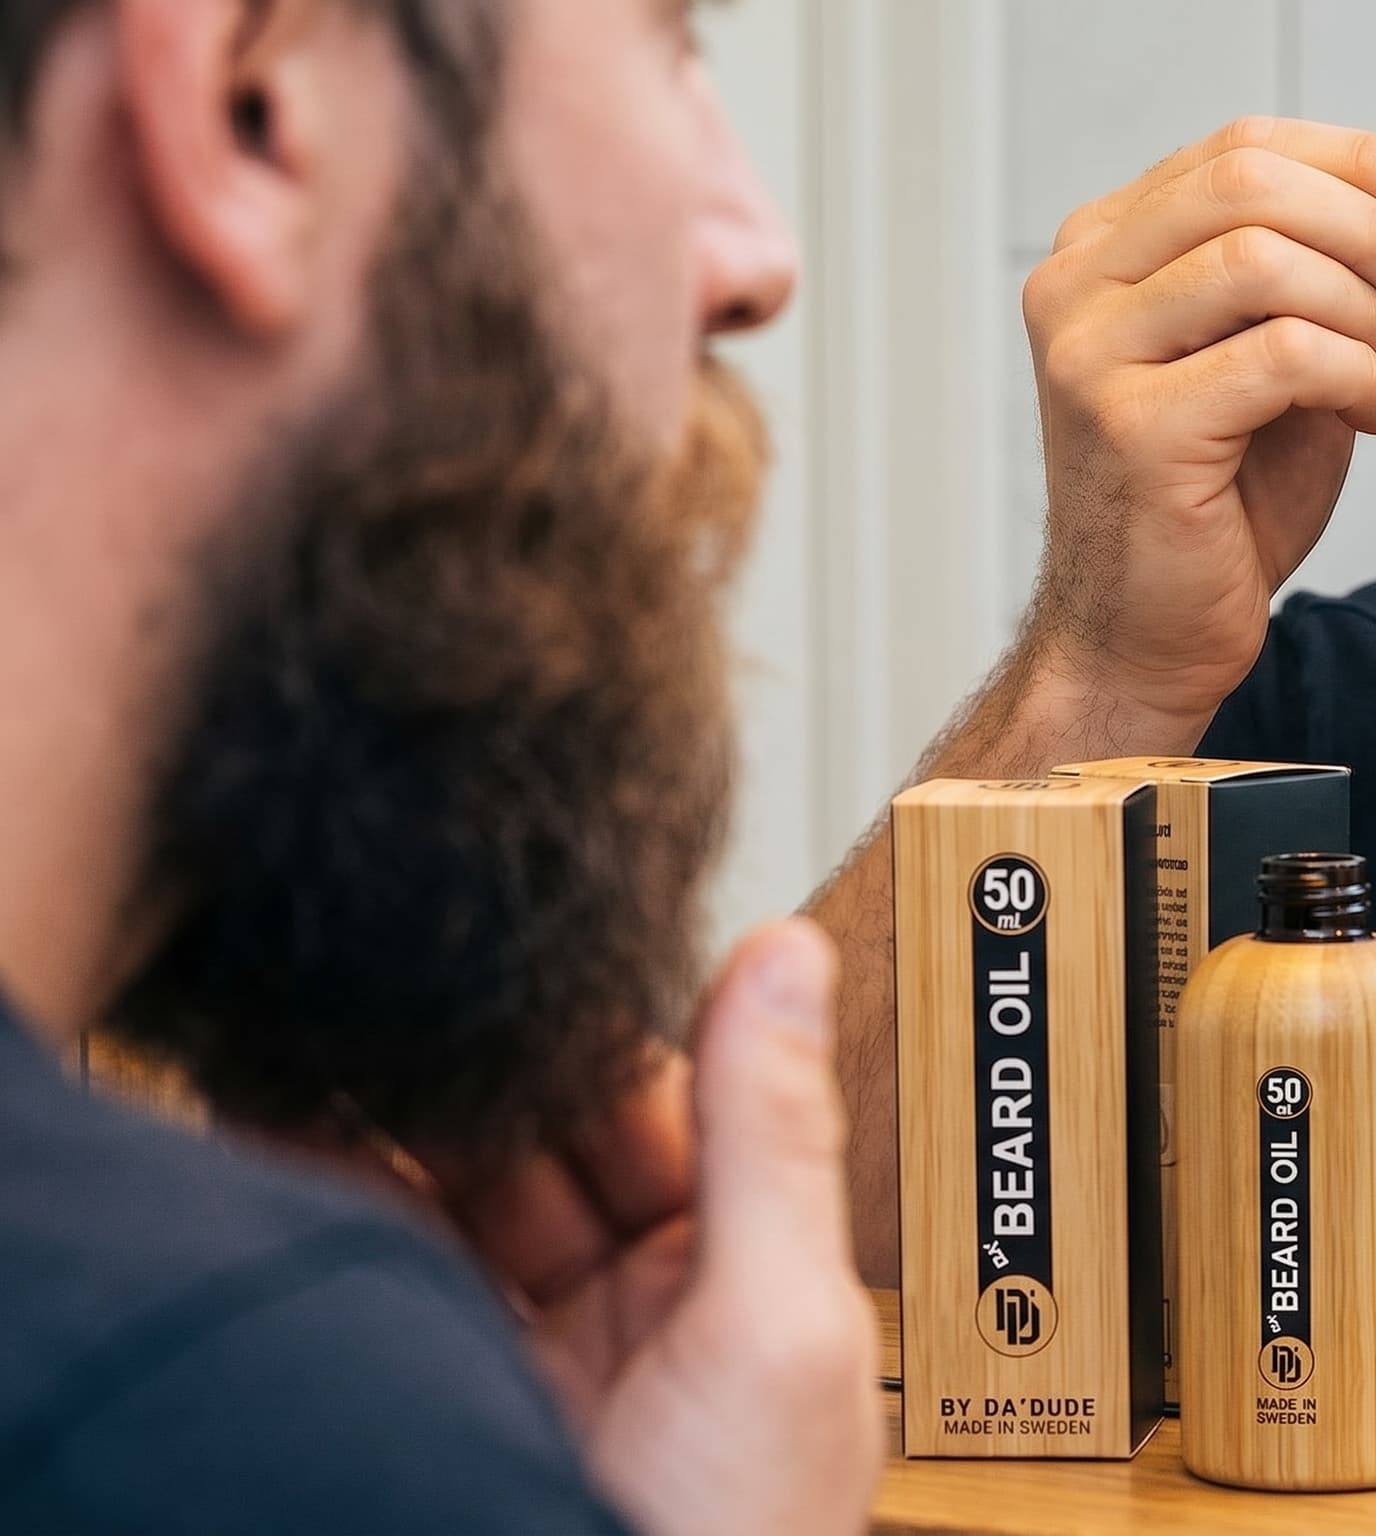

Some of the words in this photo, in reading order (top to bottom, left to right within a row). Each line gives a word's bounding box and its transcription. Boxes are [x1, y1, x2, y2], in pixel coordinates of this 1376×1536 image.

[983, 867, 1035, 911] 50
[988, 951, 1032, 1036] OIL
[1266, 1077, 1302, 1104] 50
[991, 1057, 1034, 1236] BEARD
[1270, 1131, 1299, 1185] OIL
[1271, 1198, 1299, 1312] BEARD
[940, 1398, 972, 1417] BY
[984, 1398, 1096, 1417] DA'DUDE
[1256, 1398, 1297, 1410] MADE
[1302, 1398, 1317, 1410] IN
[1256, 1412, 1317, 1425] SWEDEN
[944, 1420, 993, 1435] MADE
[997, 1420, 1015, 1435] IN
[1019, 1420, 1091, 1435] SWEDEN
